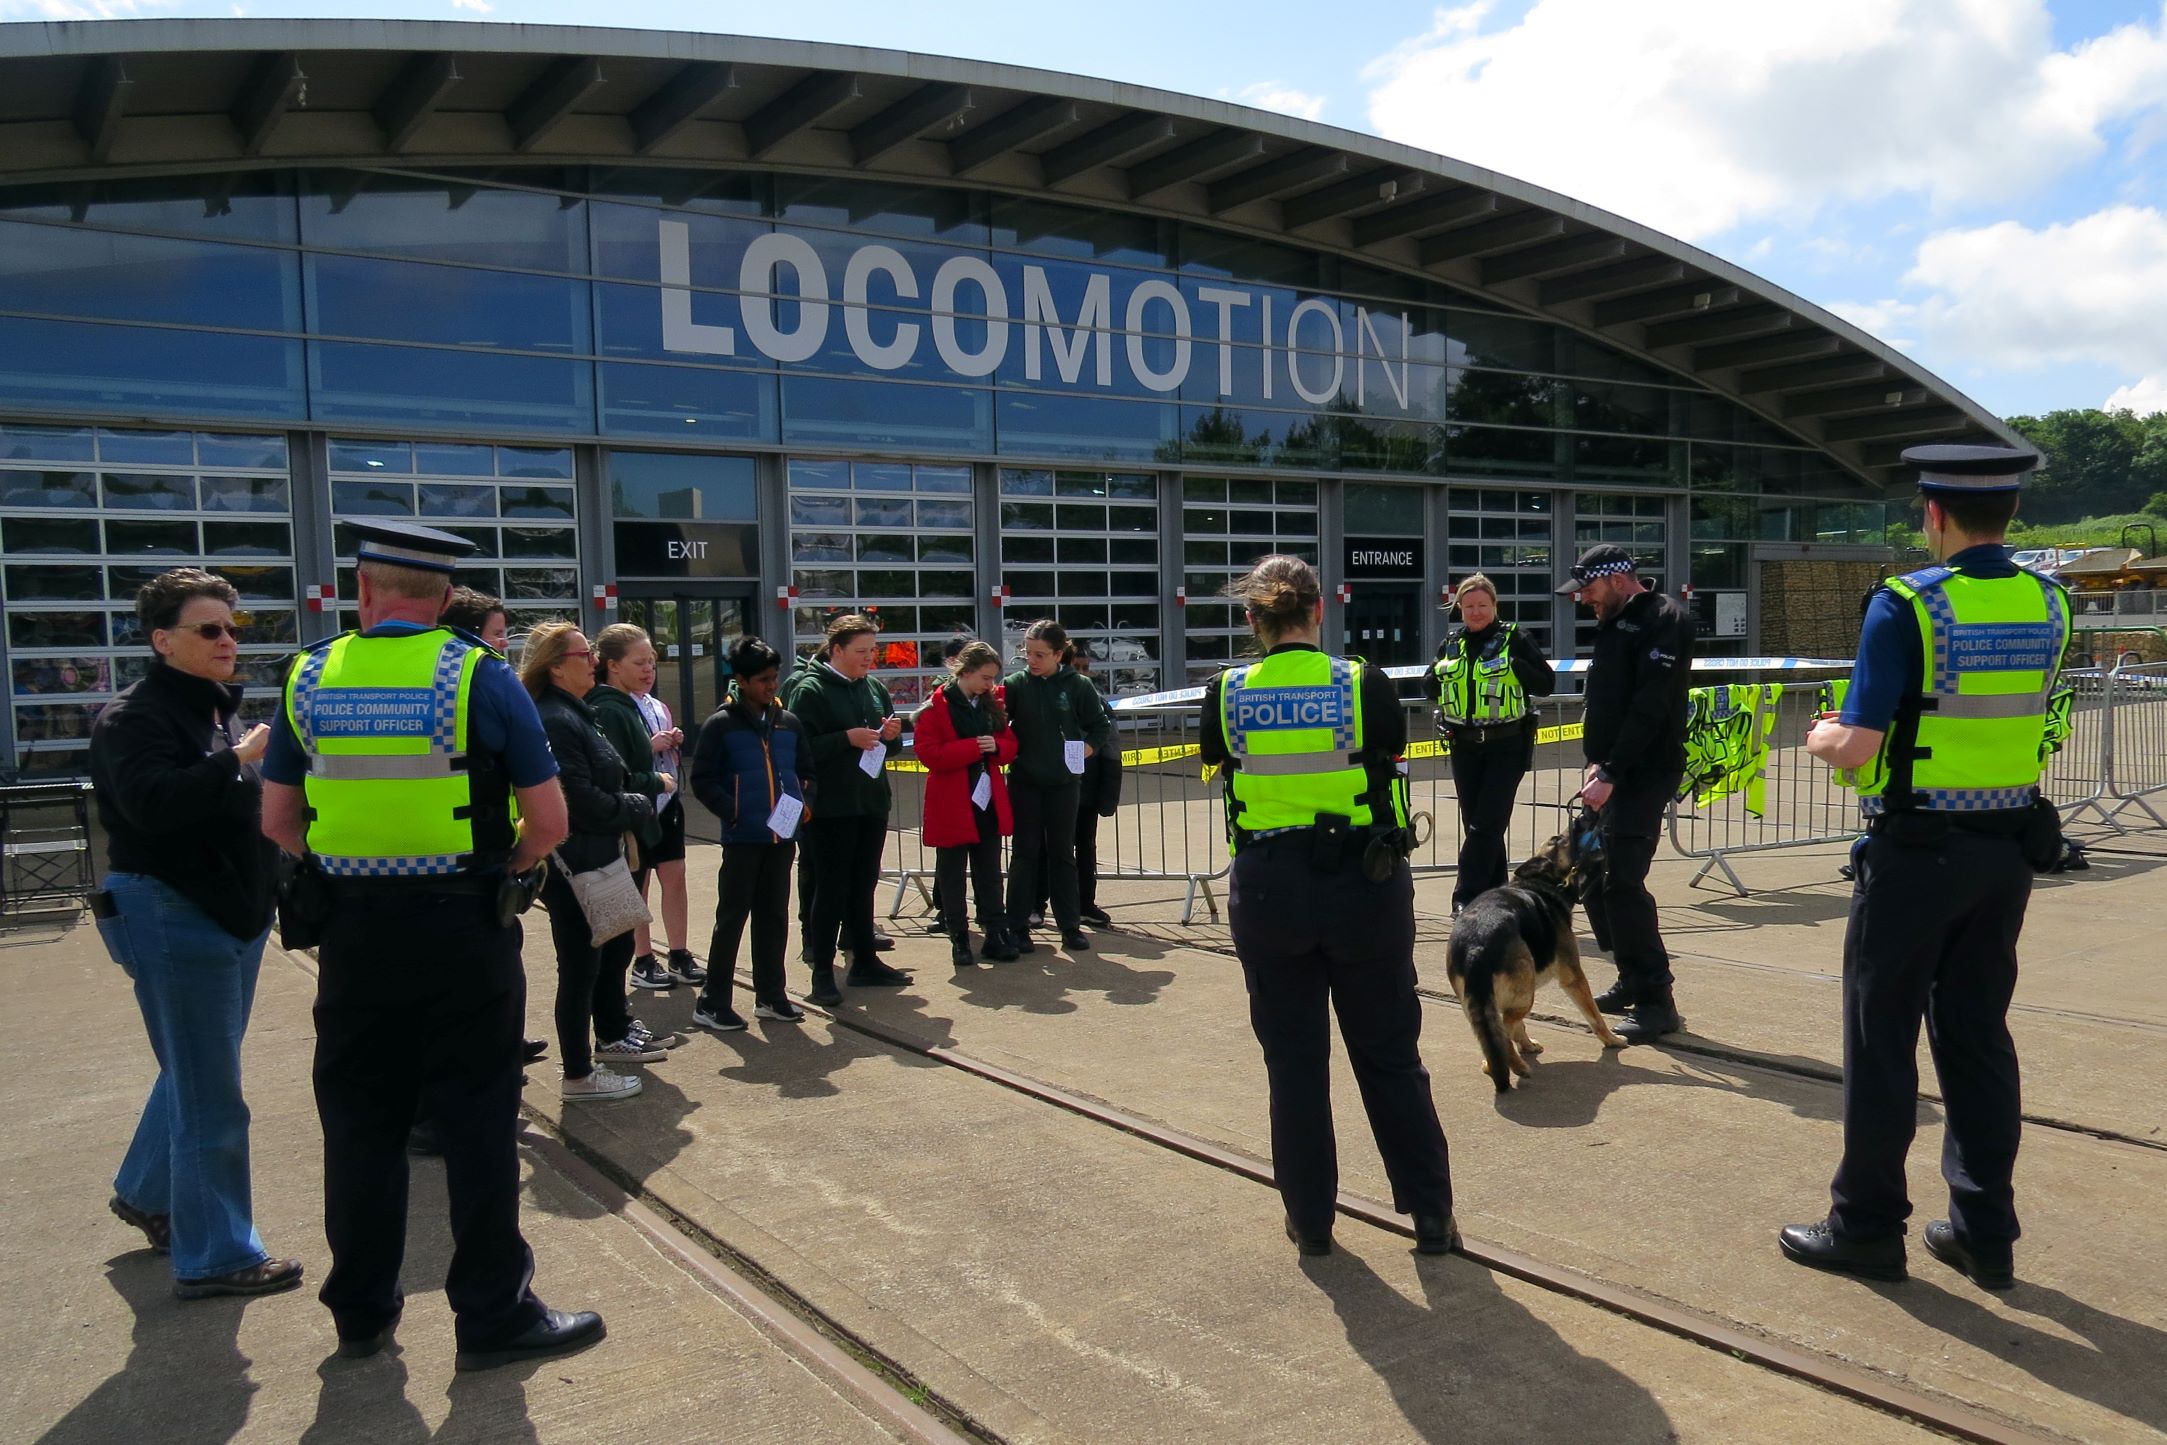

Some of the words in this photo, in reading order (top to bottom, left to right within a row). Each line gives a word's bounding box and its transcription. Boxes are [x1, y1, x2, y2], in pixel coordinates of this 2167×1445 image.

[658, 219, 1410, 411] LOCOMOTION
[668, 541, 709, 560] EXIT
[1352, 551, 1413, 566] ENTRANCE
[1952, 640, 1993, 652] POLICE
[1995, 639, 2051, 650] COMMUNITY
[1958, 655, 2008, 667] SUPPORT
[2010, 653, 2046, 665] OFFICER
[1239, 693, 1275, 703] BRITISH
[1279, 691, 1337, 701] TRANSPORT
[315, 703, 353, 716] POLICE
[356, 703, 430, 716] COMMUNITY
[1238, 702, 1338, 726] POLICE
[320, 719, 371, 731] SUPPORT
[374, 720, 424, 731] OFFICER
[1541, 728, 1560, 740] NOT
